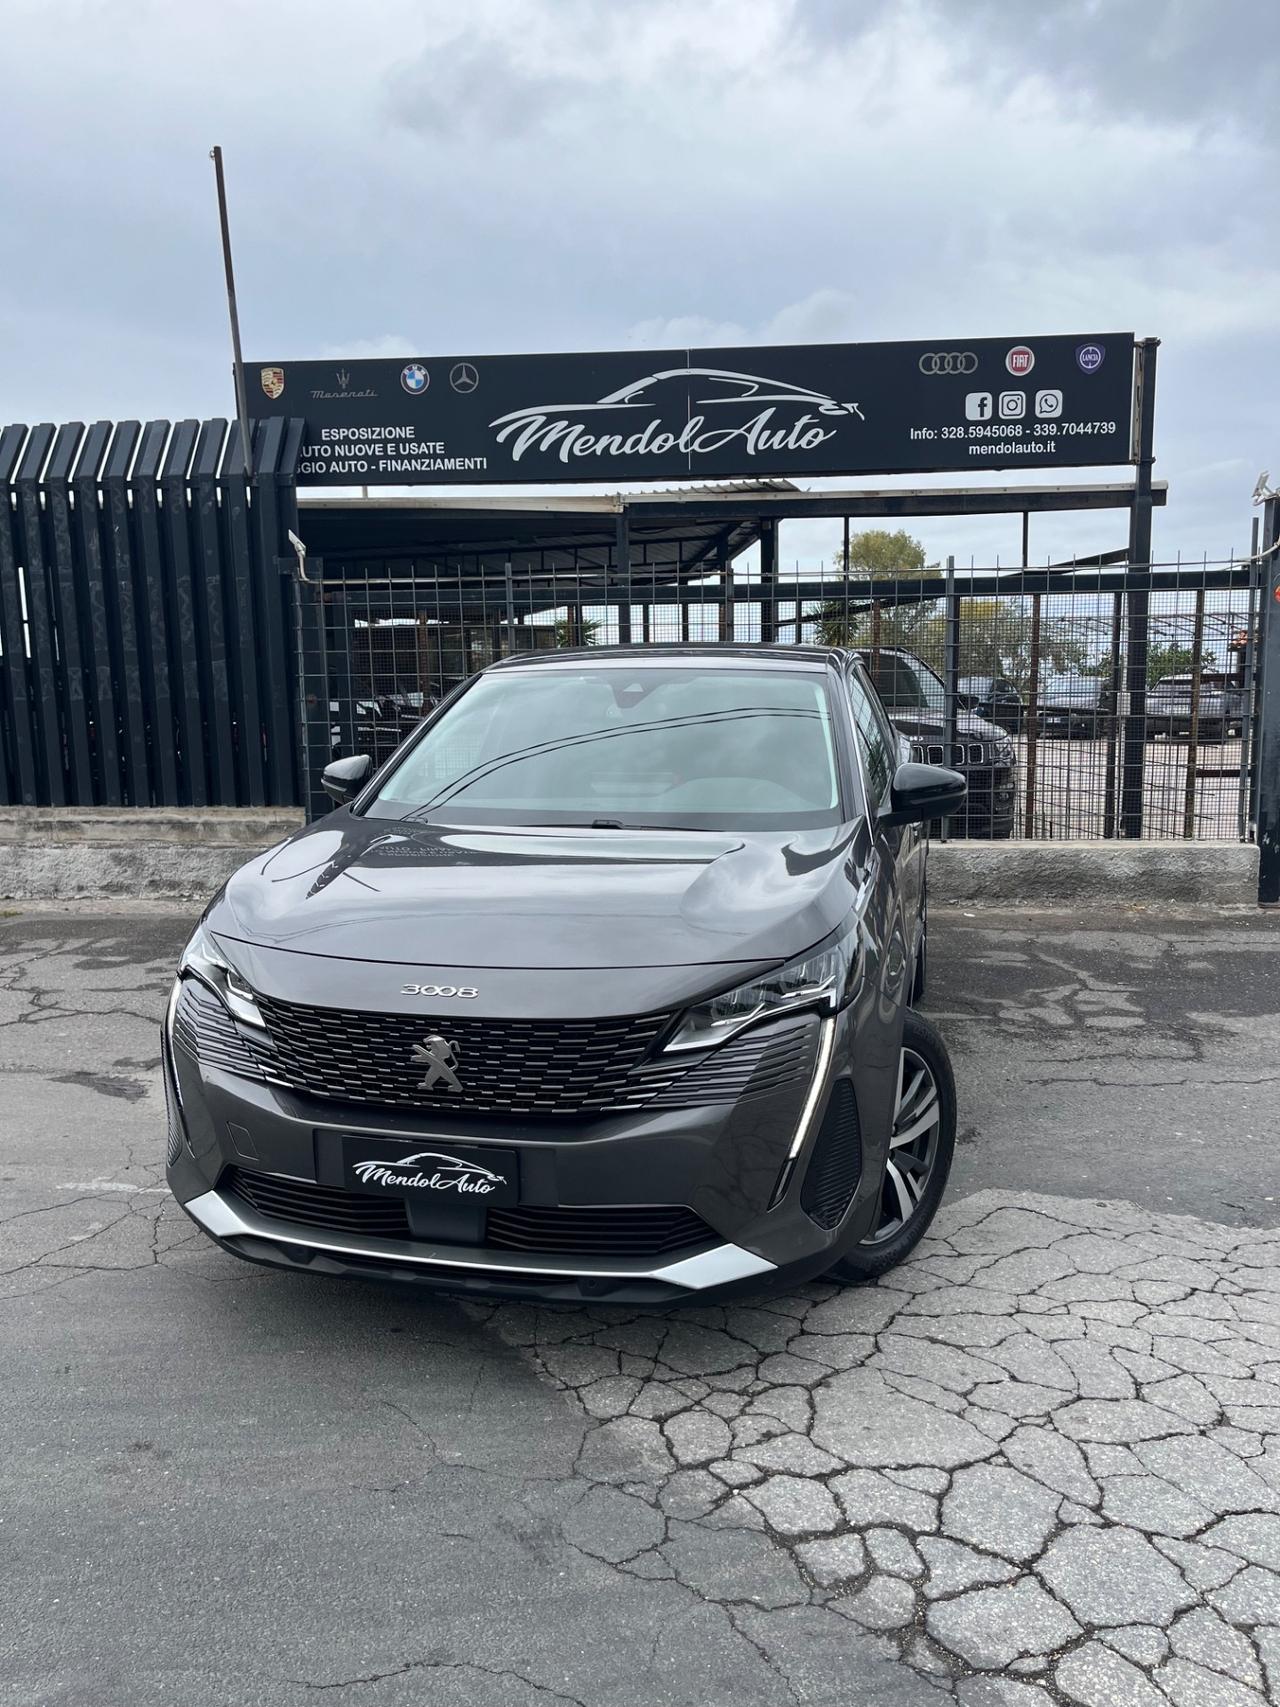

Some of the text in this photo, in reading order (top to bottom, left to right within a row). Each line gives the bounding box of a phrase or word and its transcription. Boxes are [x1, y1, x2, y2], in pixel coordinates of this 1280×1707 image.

[1012, 354, 1029, 368] FIAT
[321, 426, 415, 441] ESPOSIZIONE
[910, 427, 938, 440] Info:
[941, 424, 1023, 439] 328.5945068
[1033, 421, 1116, 436] 339.7044739
[300, 442, 445, 457] UTO NUOVE E USATE
[968, 440, 1056, 455] mendolauto.it
[329, 460, 368, 473] AUTO
[379, 457, 487, 472] FINANZIAMENTI
[400, 983, 479, 999] 3008
